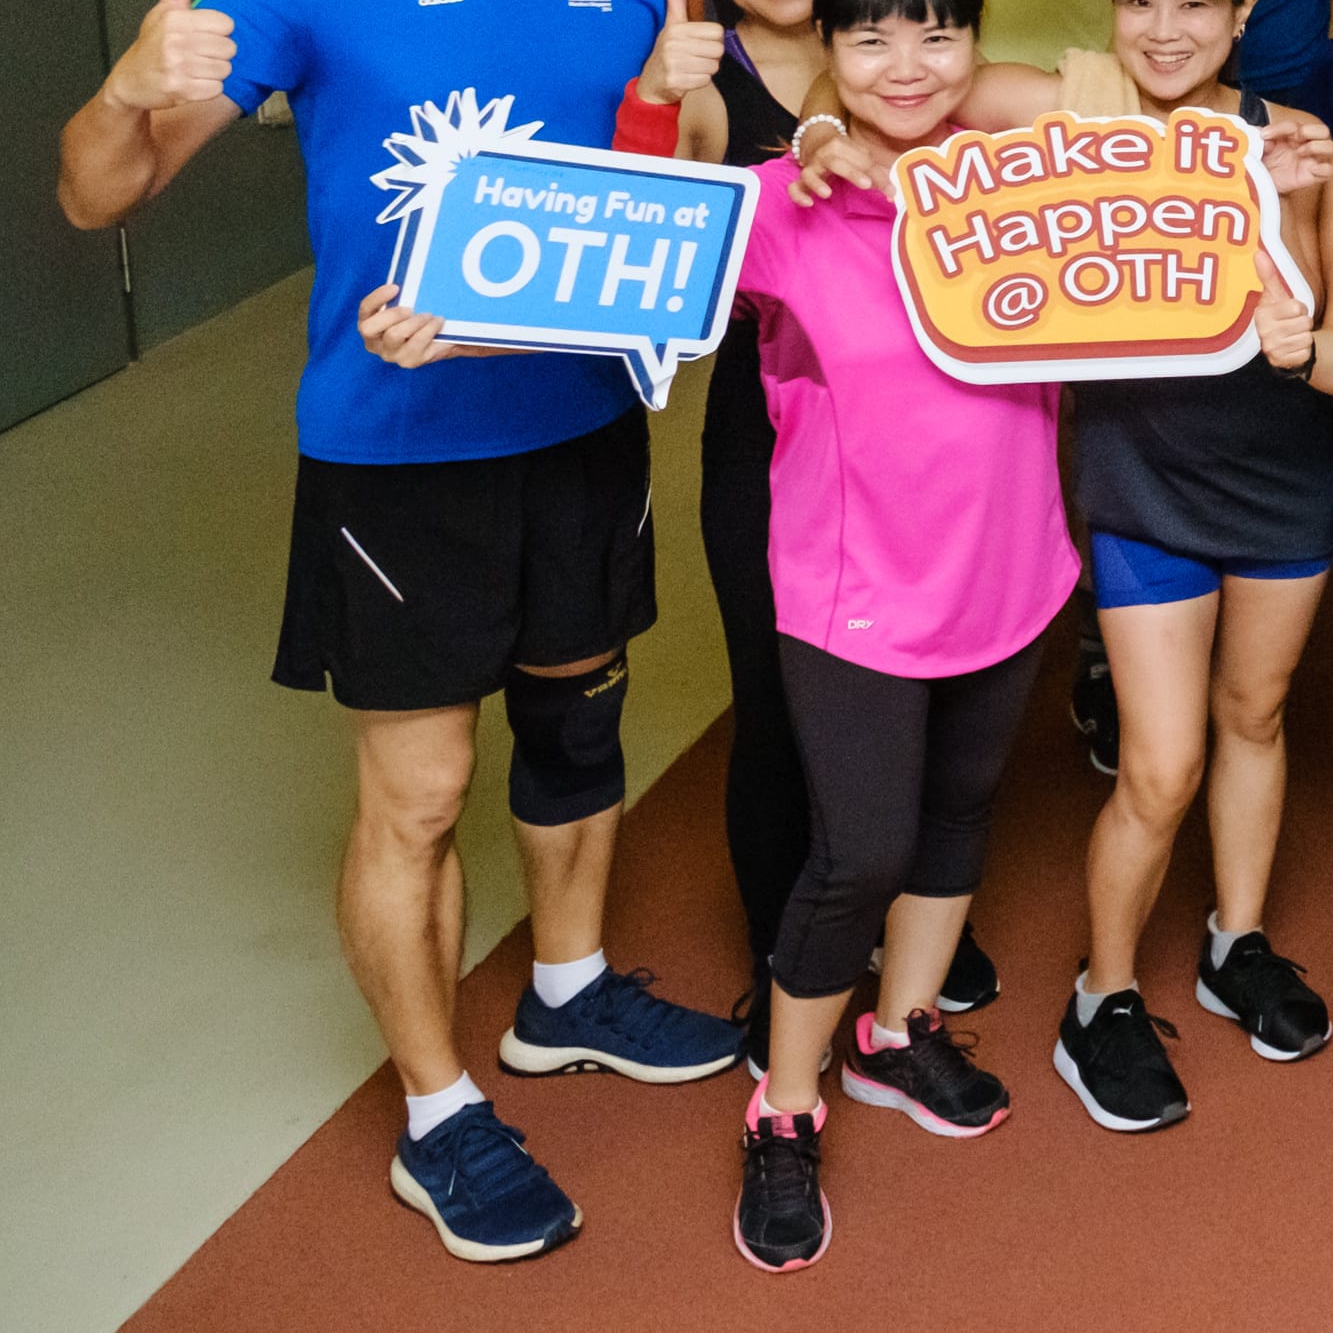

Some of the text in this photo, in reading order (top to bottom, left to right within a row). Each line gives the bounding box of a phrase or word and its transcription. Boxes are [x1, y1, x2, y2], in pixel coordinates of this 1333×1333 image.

[473, 175, 710, 229] Having Fun at
[909, 120, 1235, 214] Make it
[461, 220, 698, 313] OTH!
[930, 196, 1246, 275] Happen
[987, 252, 1215, 327] @ OTH
[847, 619, 874, 630] DRY
